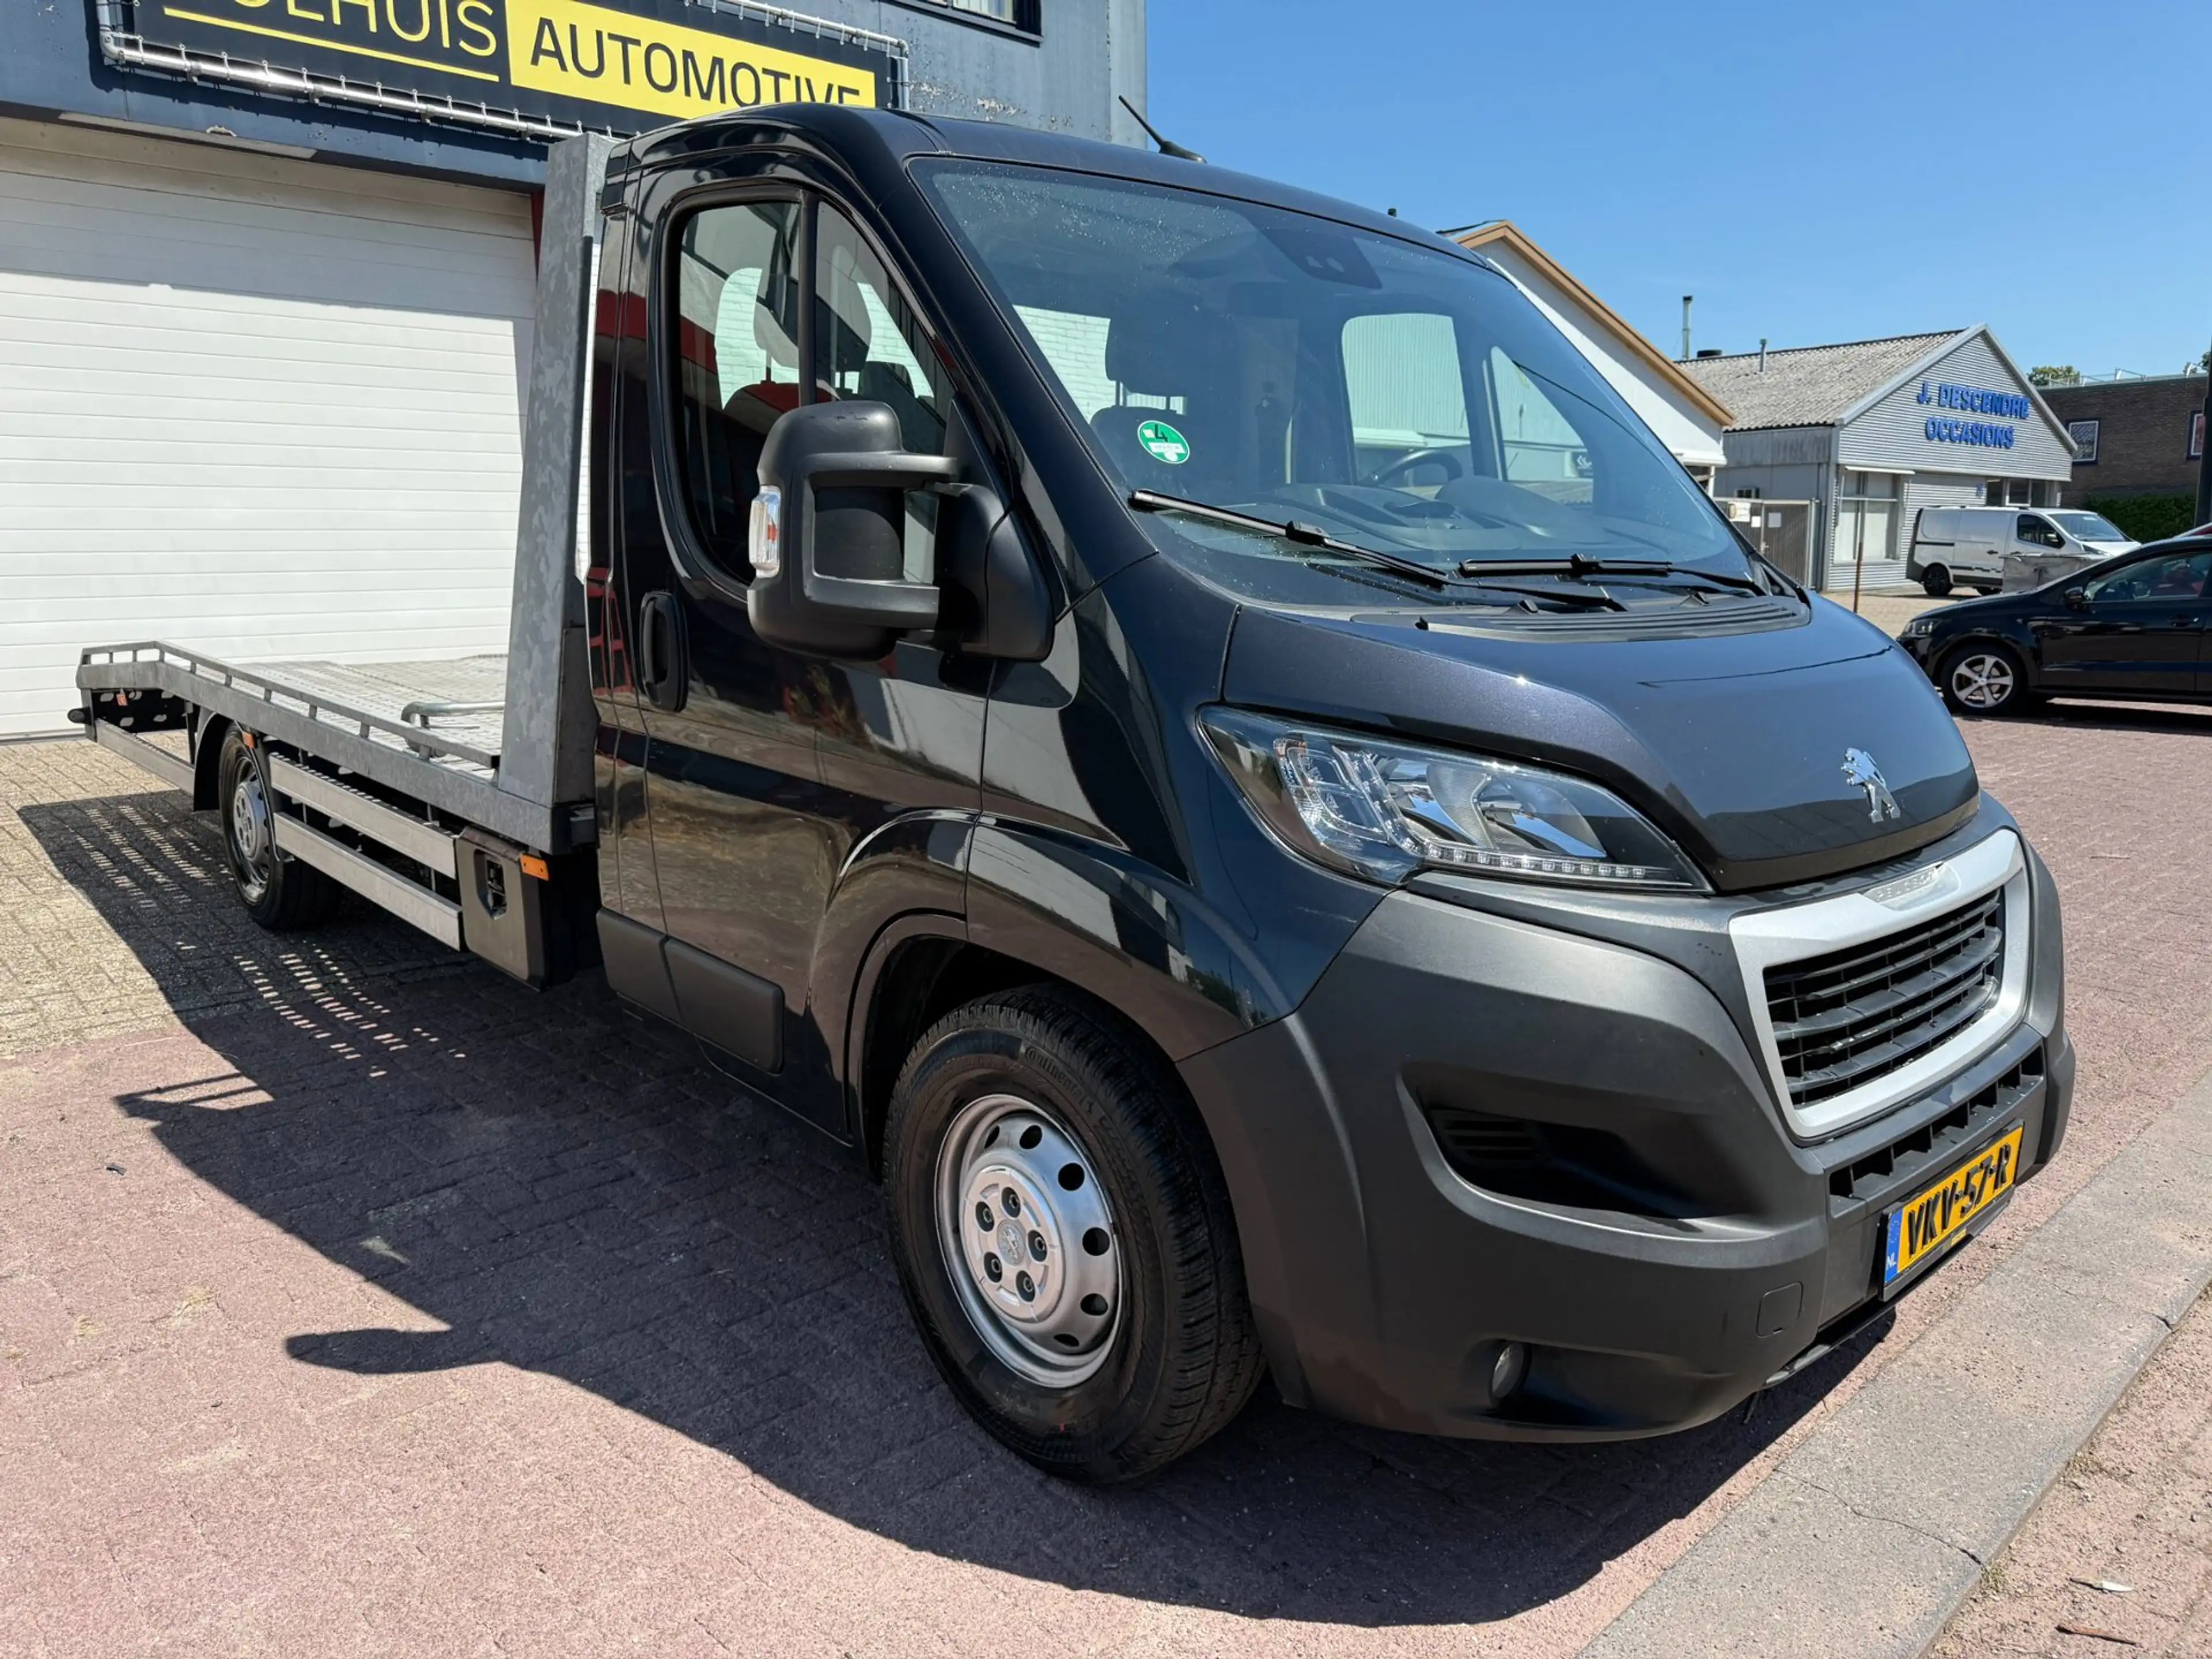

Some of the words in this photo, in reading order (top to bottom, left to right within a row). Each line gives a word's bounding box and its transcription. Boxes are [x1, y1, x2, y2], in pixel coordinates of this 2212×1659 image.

[235, 0, 497, 56] HUIS
[1154, 423, 1168, 442] 4
[1926, 416, 2014, 449] OCCASIONS
[1908, 1143, 2012, 1257] VKV-57-R
[1886, 1252, 1897, 1270] NL
